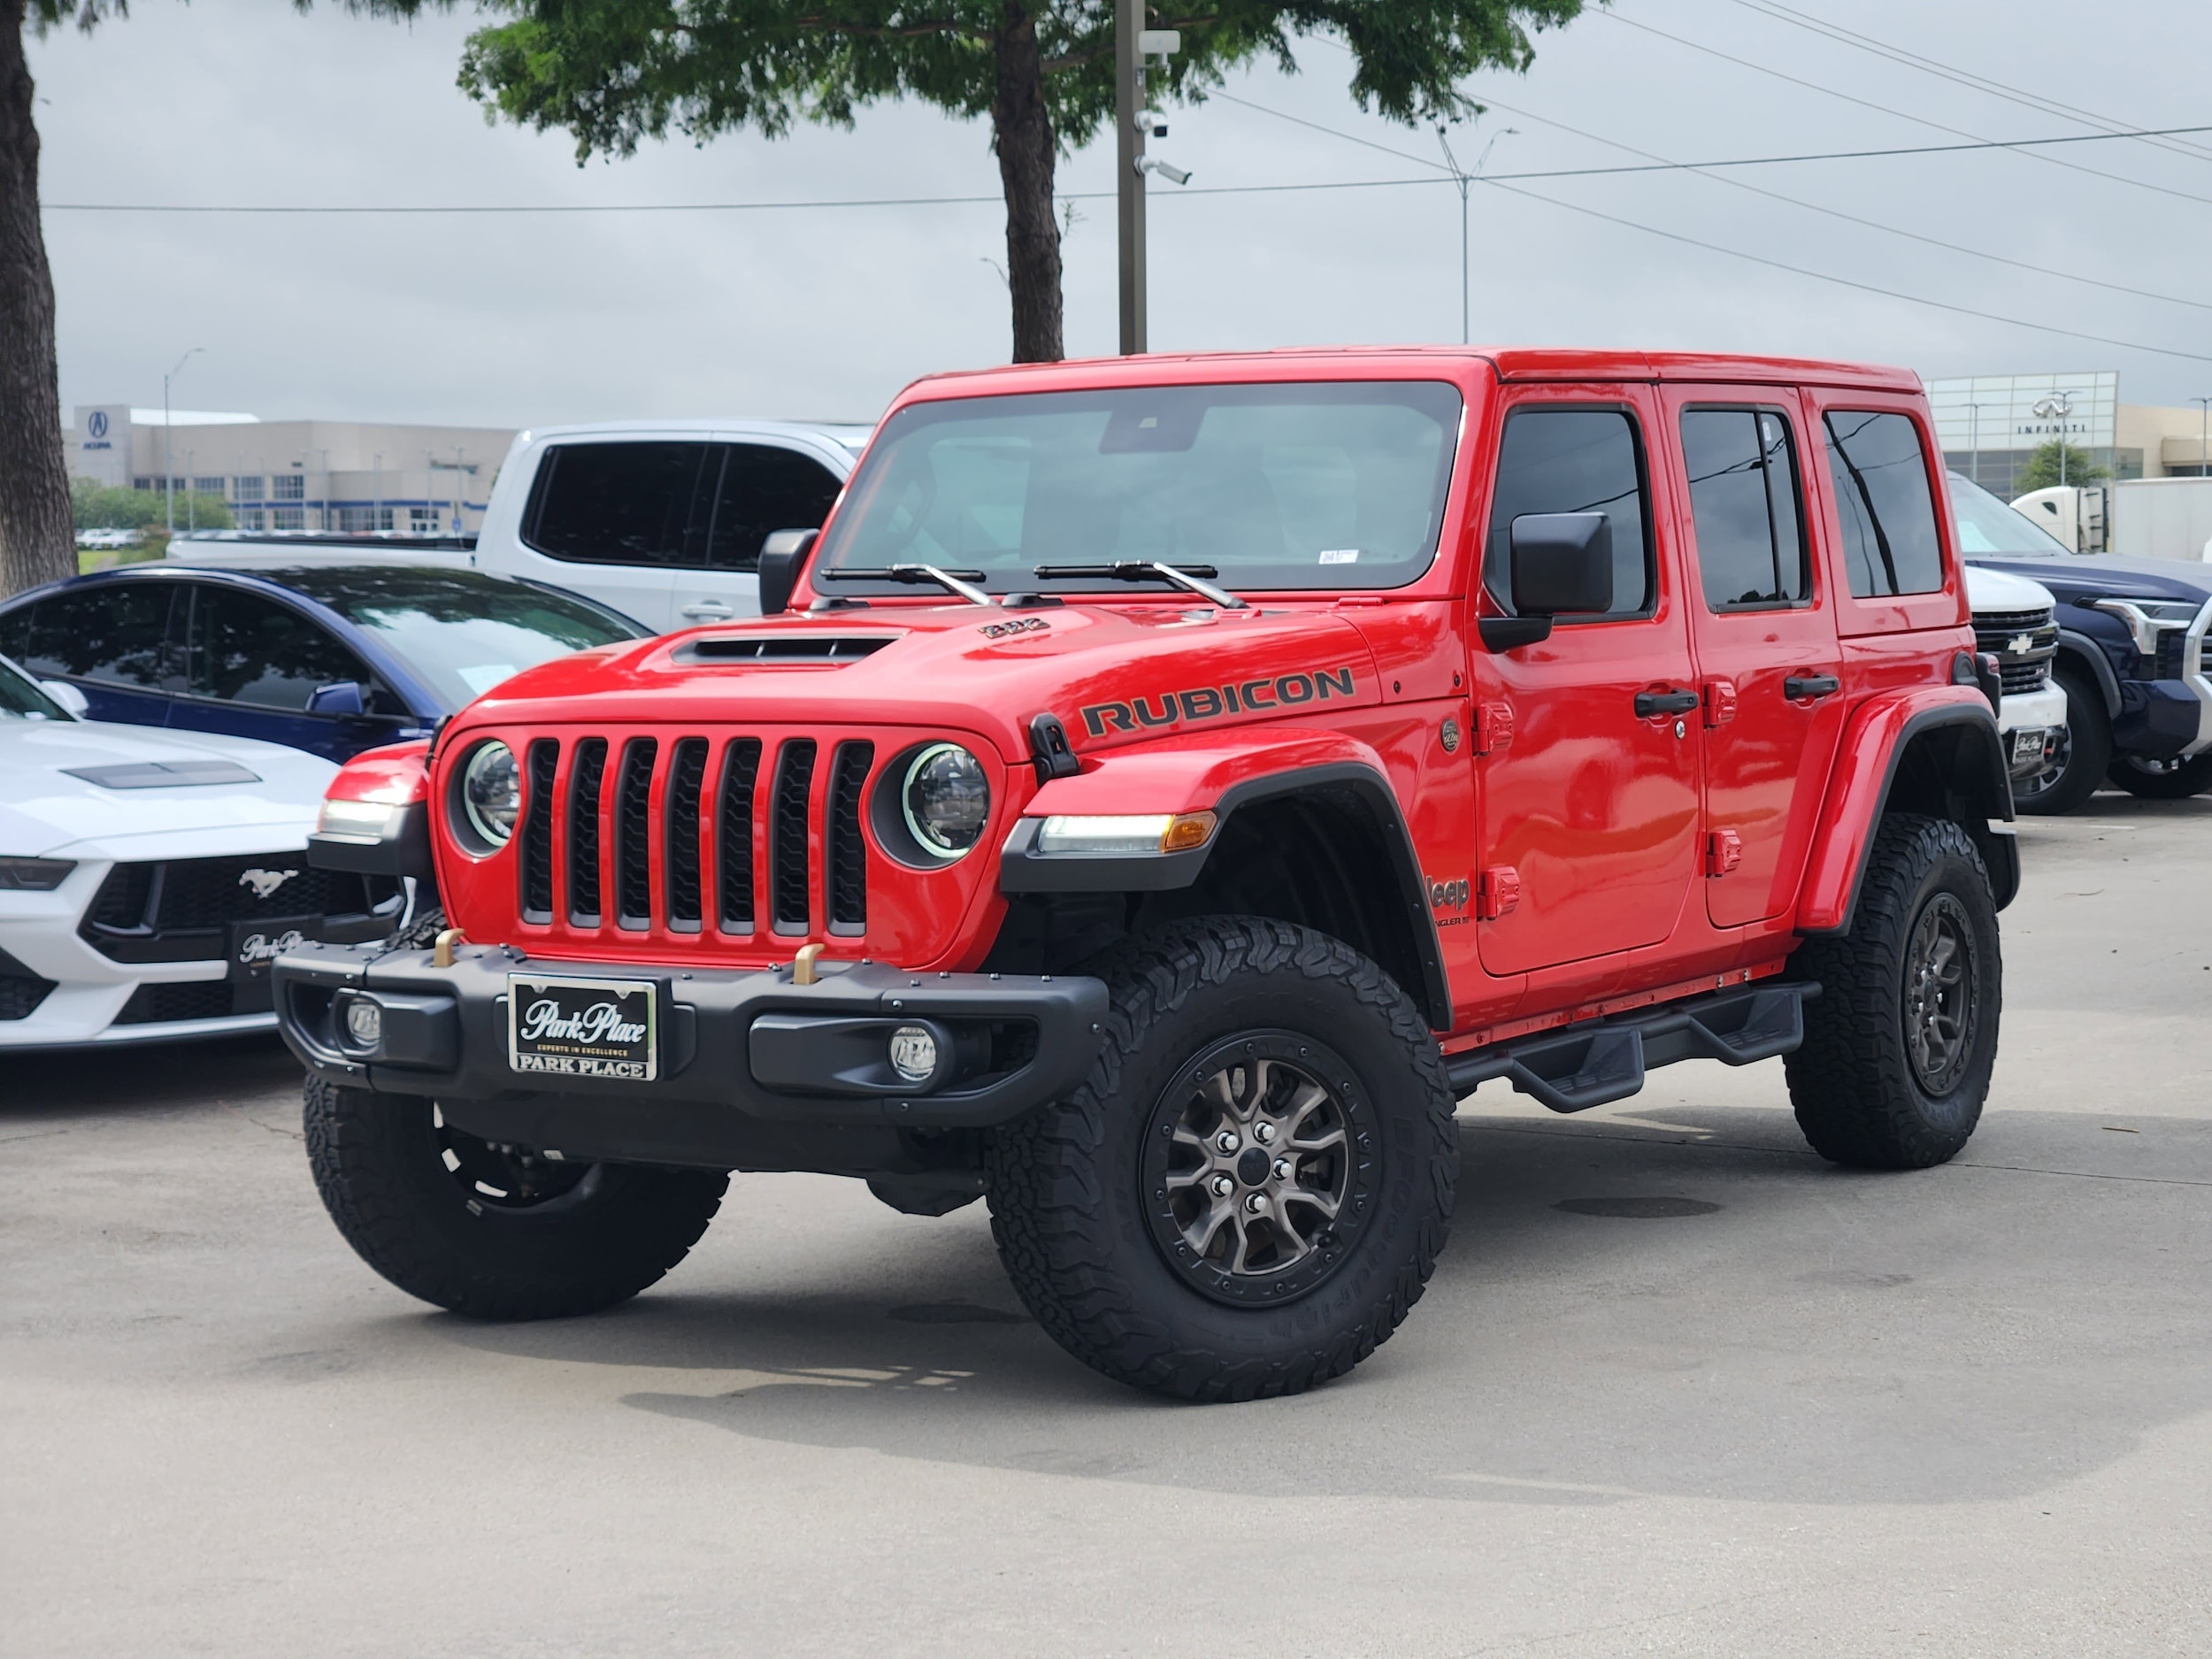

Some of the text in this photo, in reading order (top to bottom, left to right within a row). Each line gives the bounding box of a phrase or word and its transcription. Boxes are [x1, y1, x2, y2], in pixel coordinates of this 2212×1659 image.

[2017, 424, 2085, 434] INFINITI
[1079, 667, 1356, 739] RUBICON
[520, 999, 647, 1044] Park Place
[536, 1043, 570, 1053] EXPERTS
[581, 1047, 628, 1057] EXCELLENCE
[518, 1055, 645, 1078] PARK PLACE
